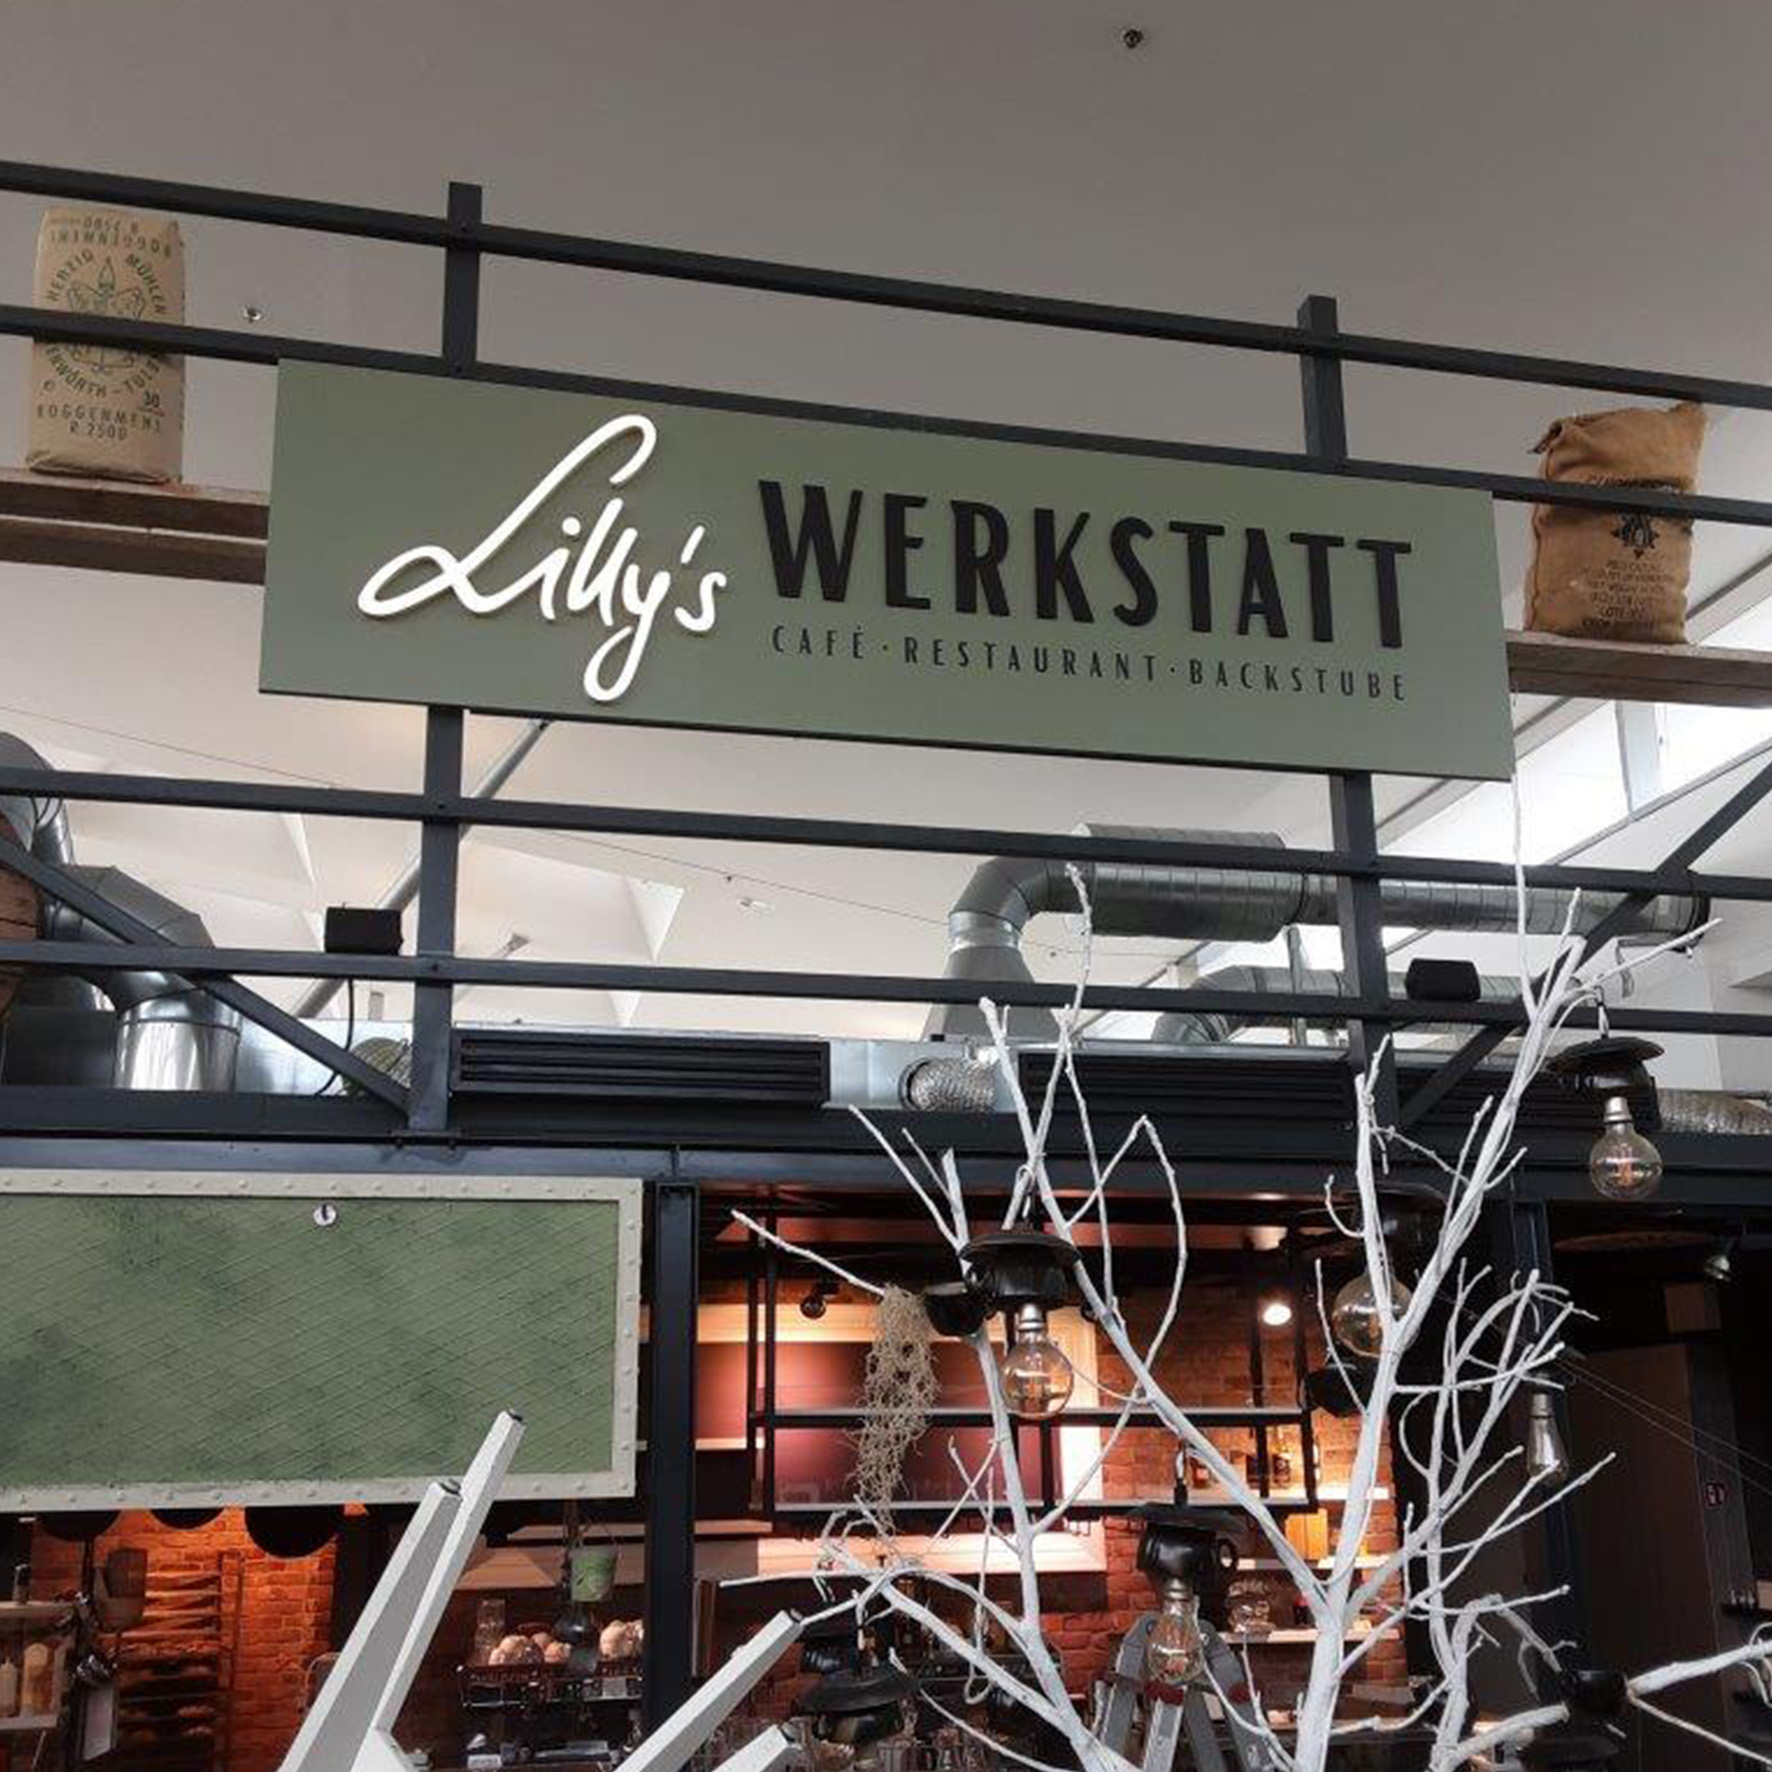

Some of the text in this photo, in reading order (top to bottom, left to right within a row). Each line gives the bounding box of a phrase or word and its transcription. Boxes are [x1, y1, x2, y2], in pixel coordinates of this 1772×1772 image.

[357, 413, 727, 701] Lilly's
[758, 480, 1412, 649] WERKSTATT
[772, 625, 1406, 701] CAFÉ RESTAURANT BACKSTUBE
